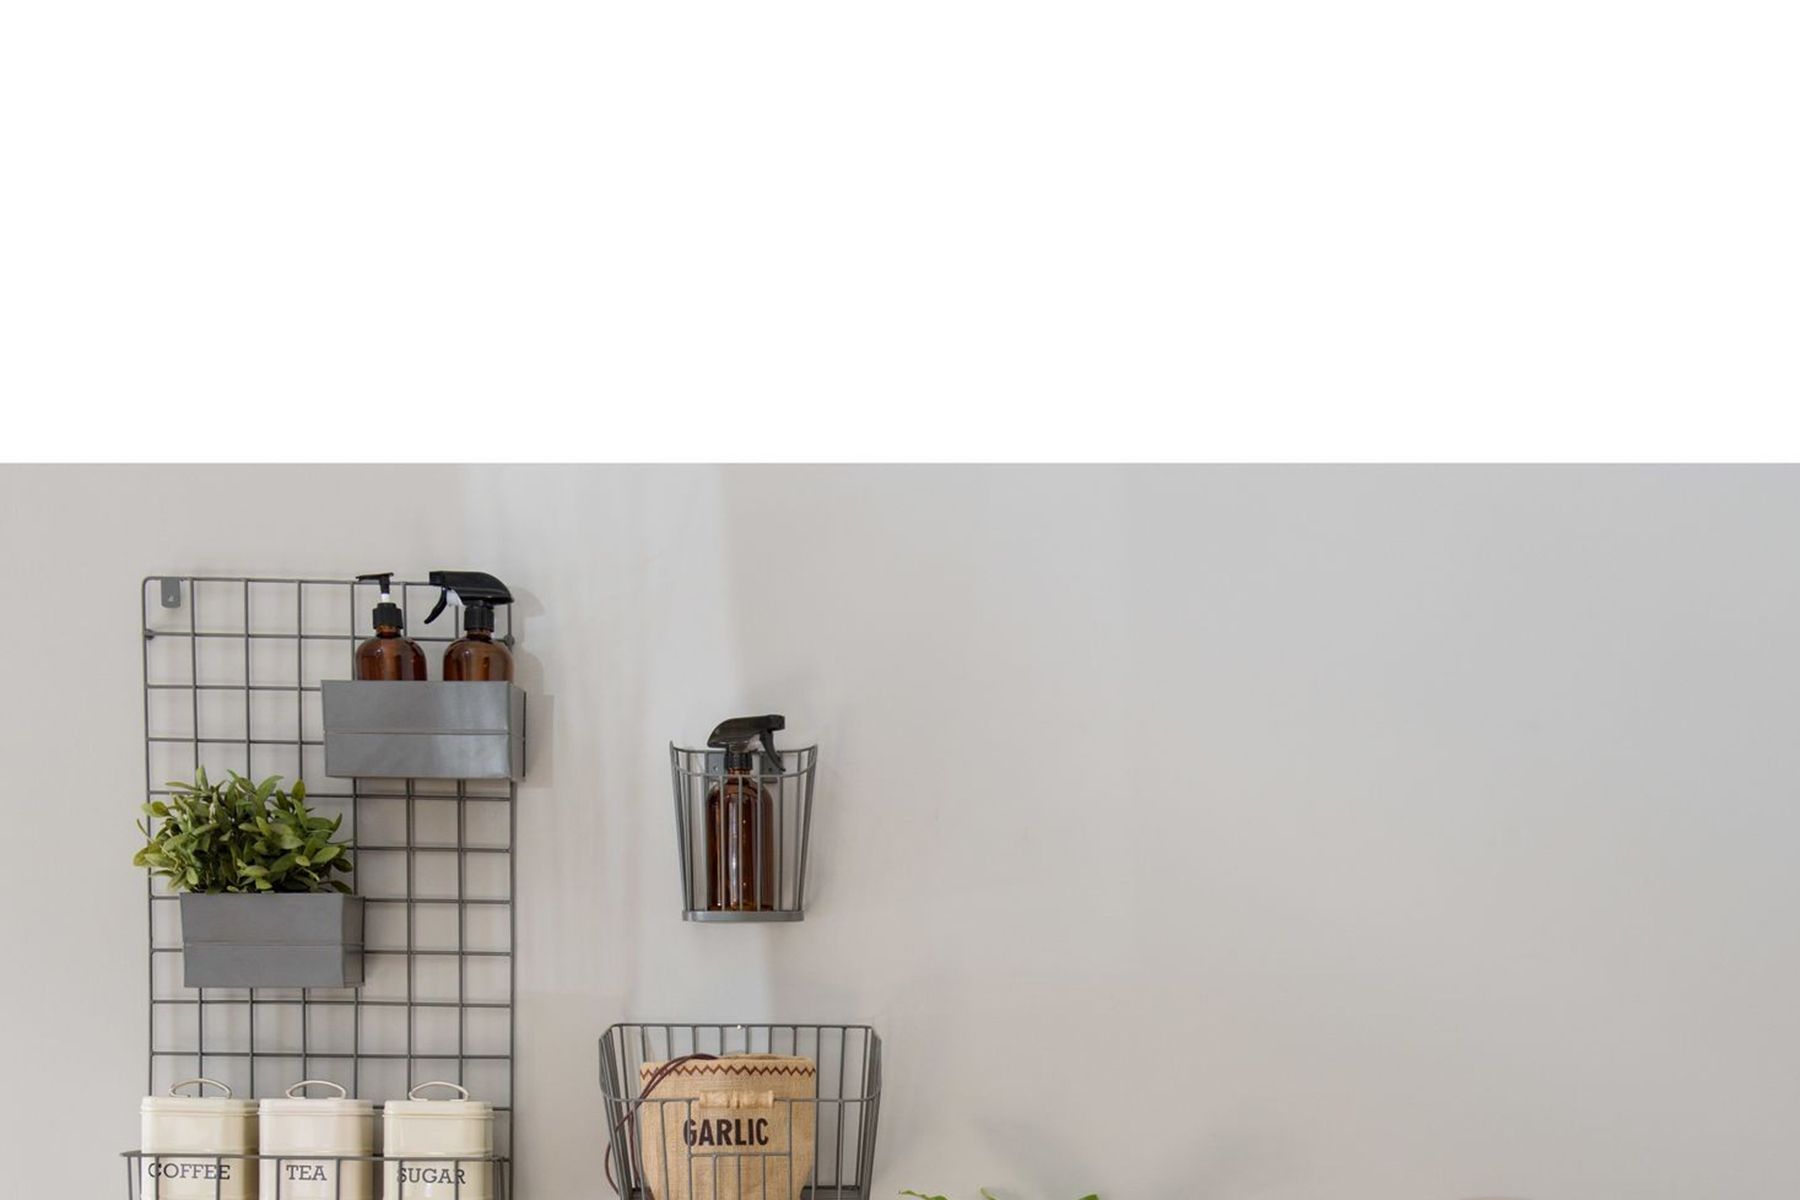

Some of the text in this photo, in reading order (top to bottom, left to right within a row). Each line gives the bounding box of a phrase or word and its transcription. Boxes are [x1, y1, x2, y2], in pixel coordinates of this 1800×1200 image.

[683, 1118, 769, 1146] GARLIC
[148, 1163, 231, 1180] COFFEE
[286, 1165, 327, 1181] TEA
[397, 1167, 466, 1185] SUGAR
